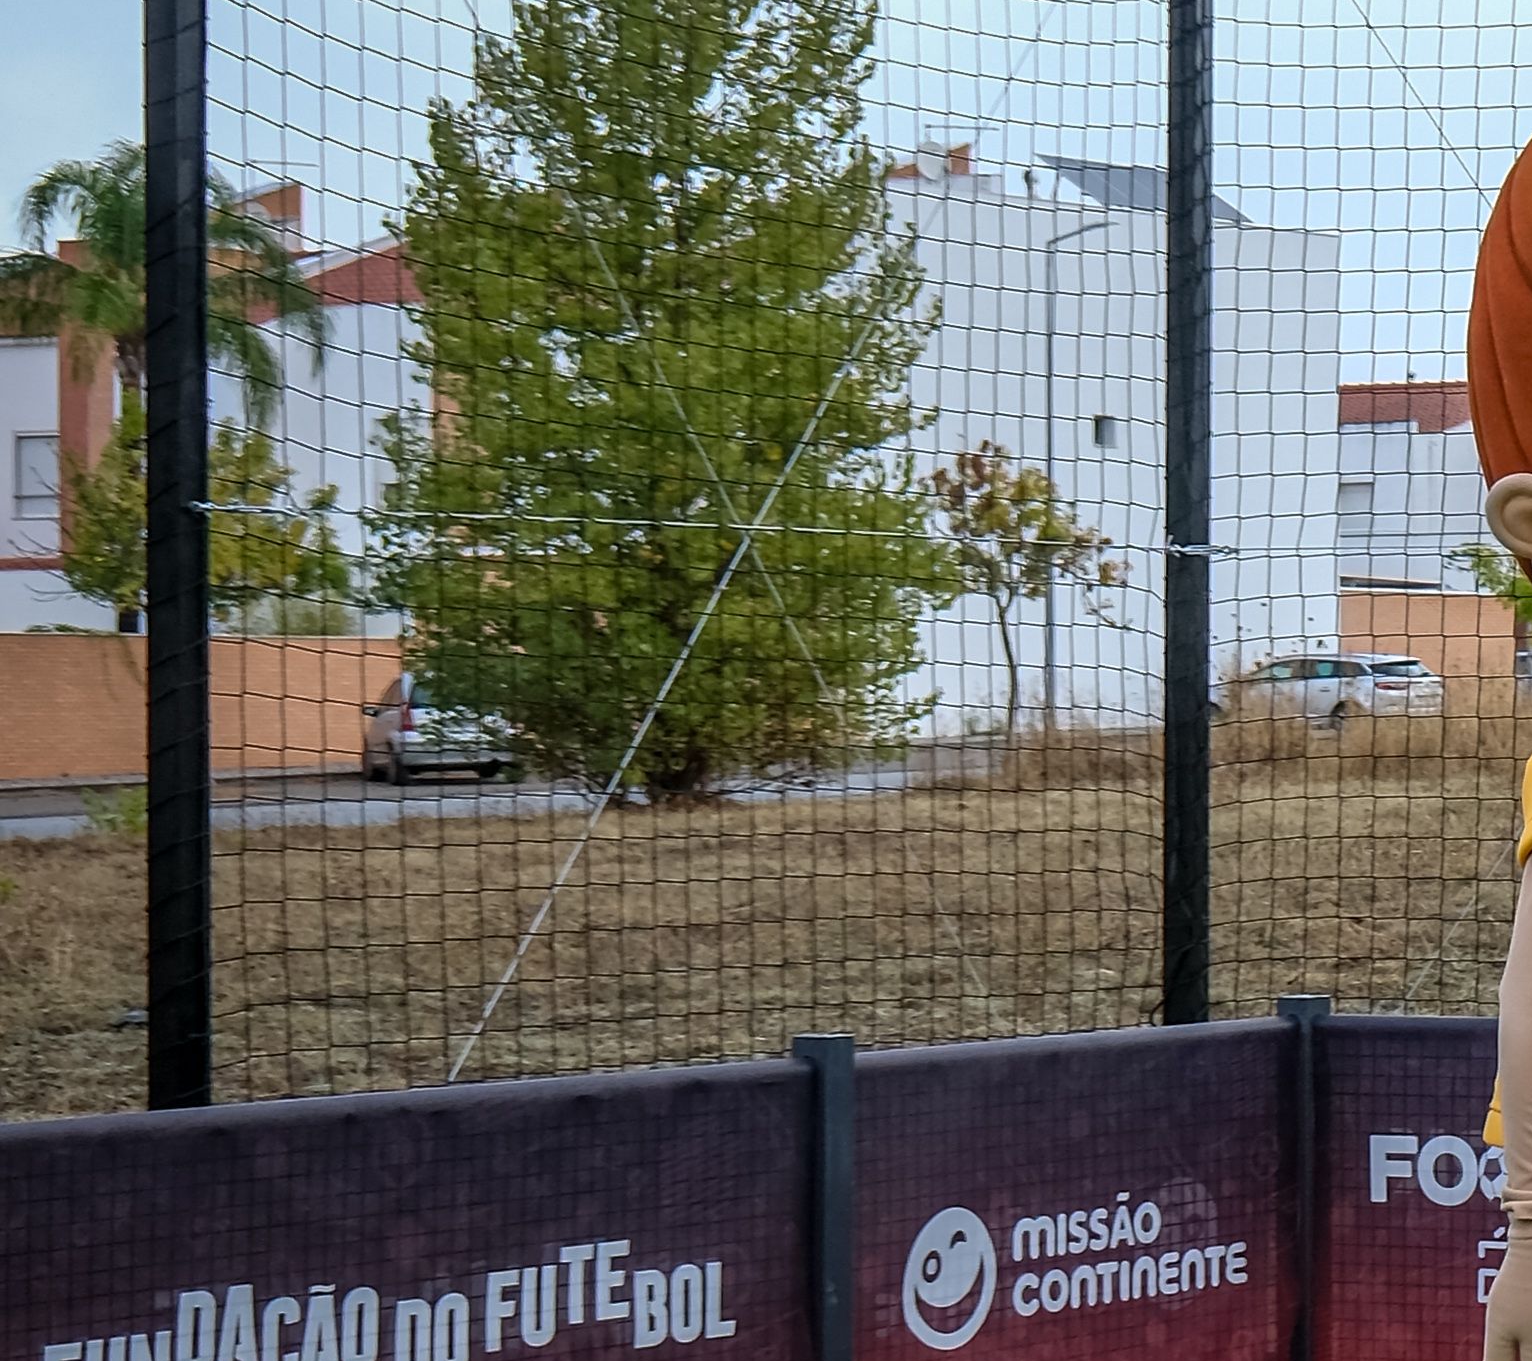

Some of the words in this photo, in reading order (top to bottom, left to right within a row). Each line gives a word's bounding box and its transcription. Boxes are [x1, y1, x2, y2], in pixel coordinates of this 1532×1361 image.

[1012, 1191, 1162, 1262] MISSÃO
[484, 1239, 737, 1353] FUTEBOL
[1012, 1241, 1249, 1317] CONTINENTE
